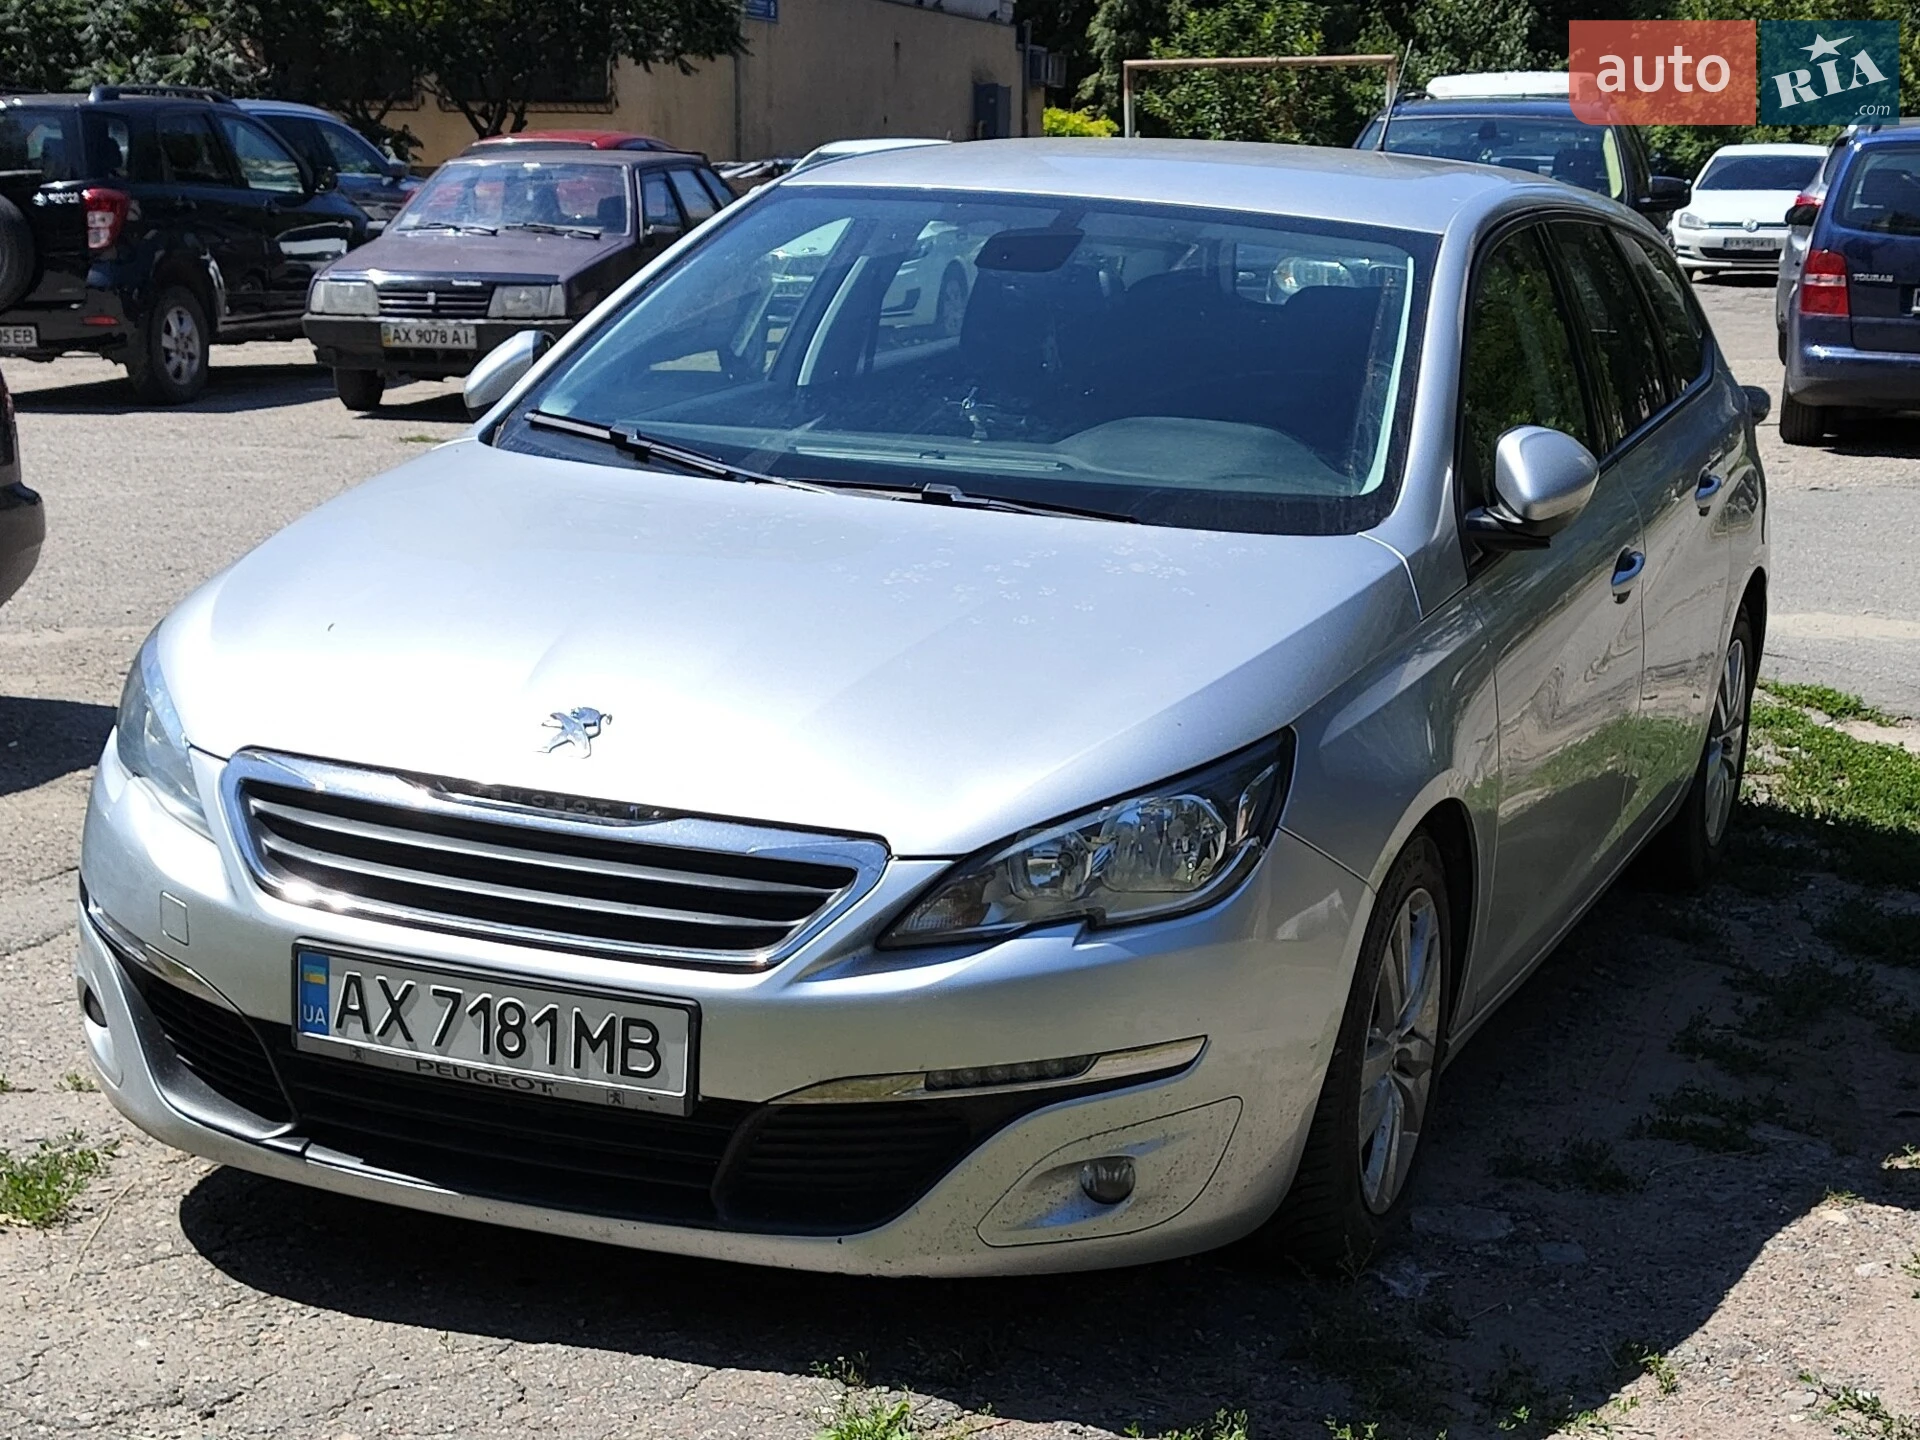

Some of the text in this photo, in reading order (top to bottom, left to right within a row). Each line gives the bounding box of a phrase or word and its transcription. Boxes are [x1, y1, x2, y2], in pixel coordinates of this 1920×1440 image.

[1852, 273, 1894, 283] TOURAN
[13, 329, 33, 344] EB
[392, 328, 412, 343] AX
[415, 329, 448, 344] 9078
[302, 1003, 327, 1025] UA
[334, 971, 663, 1079] AX 7181 MB
[414, 1059, 555, 1095] PEUGEOT
